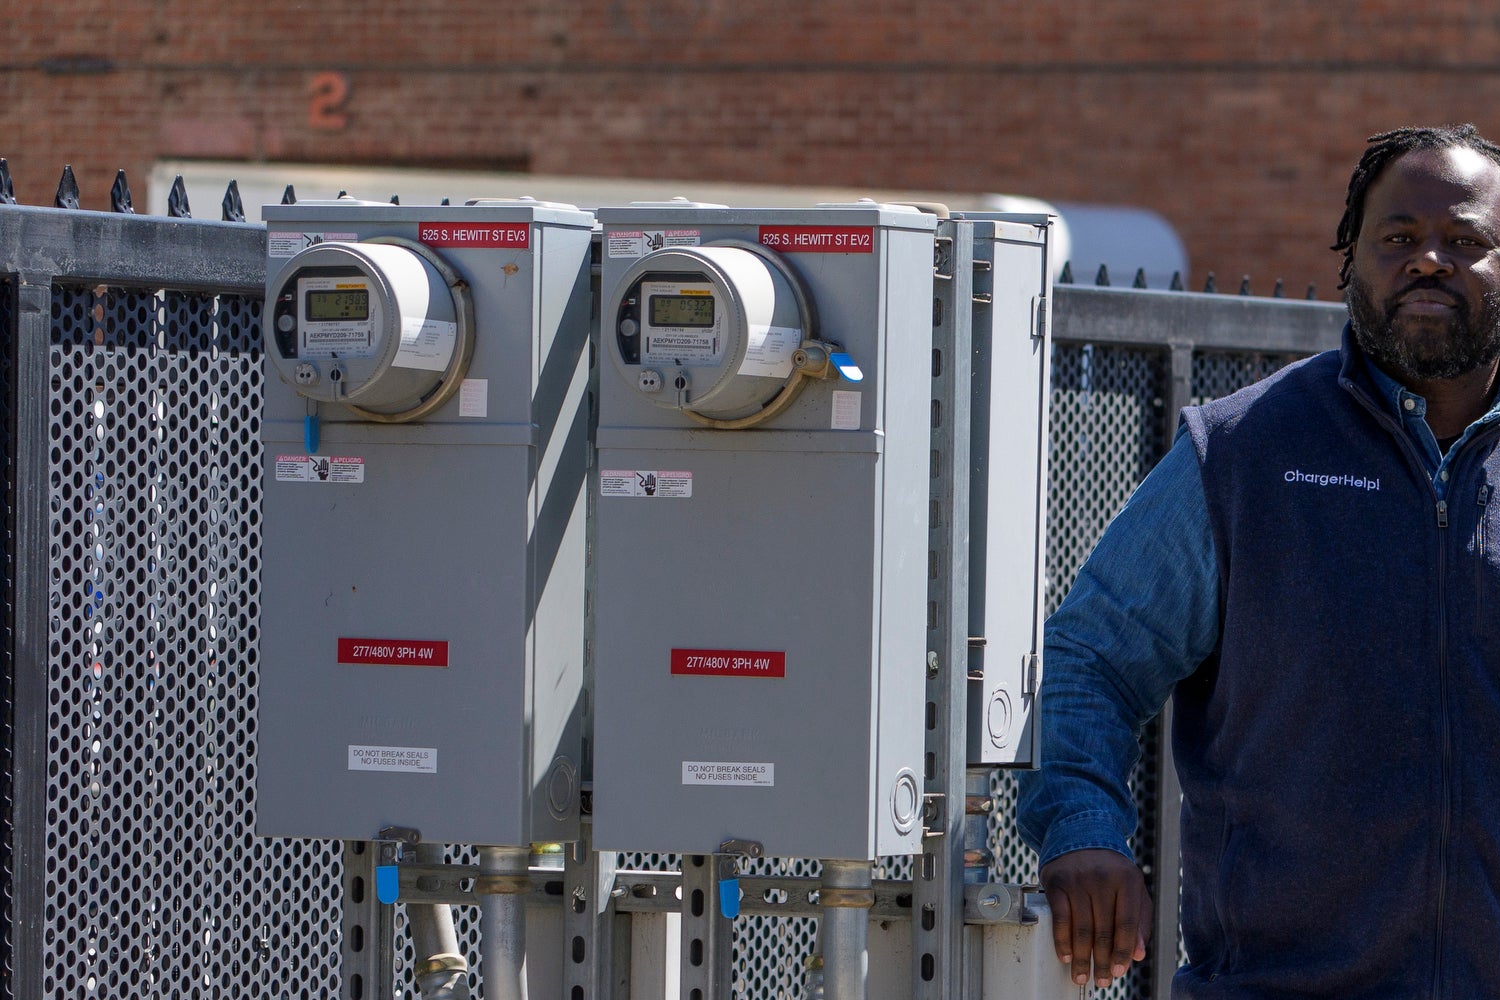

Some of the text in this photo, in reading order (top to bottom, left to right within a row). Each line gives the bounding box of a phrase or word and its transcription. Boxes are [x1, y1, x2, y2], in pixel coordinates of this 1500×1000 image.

[306, 72, 348, 131] 2
[422, 229, 526, 242] 525 S. HEWITT ST EV3
[762, 233, 870, 247] 525 S. HEWITT ST EV2
[1284, 469, 1380, 491] ChargerHelp!
[352, 645, 434, 659] 277/480V 3PH 4W
[686, 656, 770, 670] 277/480V 3PH 4W
[361, 757, 372, 765] NO
[373, 758, 396, 766] FUSES
[708, 773, 732, 781] FUSES
[742, 766, 766, 774] SEALS
